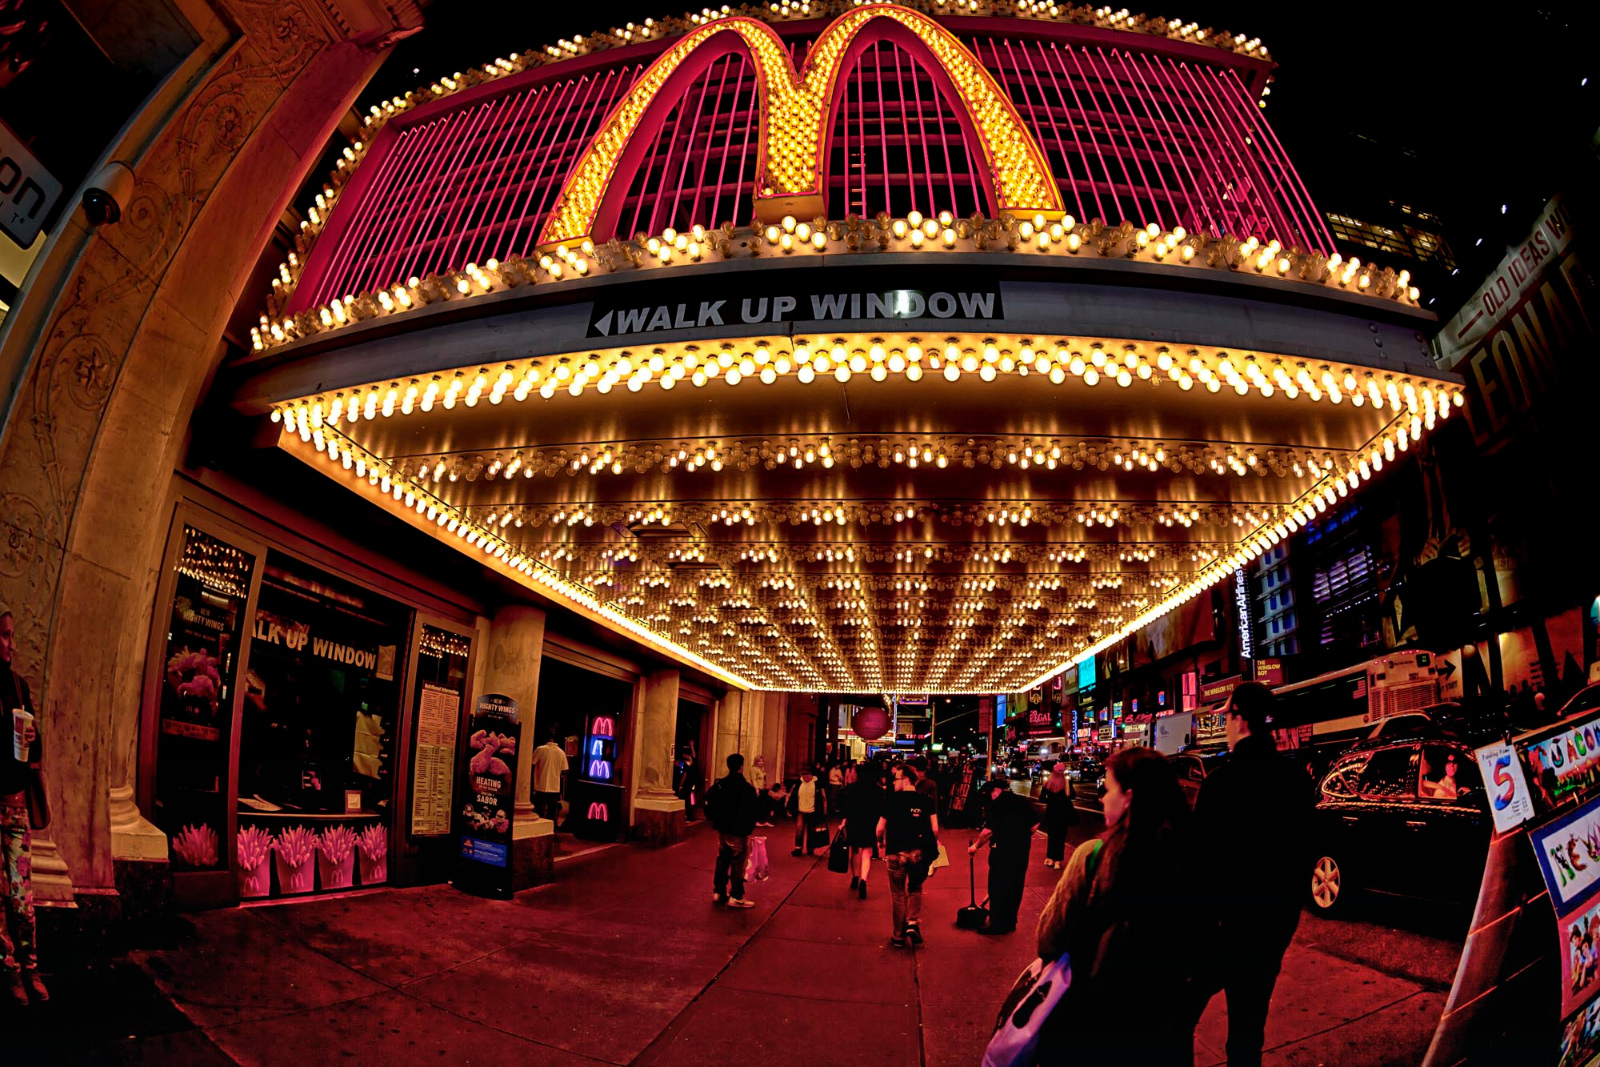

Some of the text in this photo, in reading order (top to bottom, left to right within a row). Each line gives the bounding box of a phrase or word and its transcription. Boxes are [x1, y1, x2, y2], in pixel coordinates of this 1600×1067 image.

[1482, 276, 1511, 316] OLD
[1507, 230, 1551, 288] IDEAS
[617, 292, 995, 334] WALK UP WINDOW
[205, 617, 225, 632] WINGS
[286, 629, 309, 651] UP
[313, 637, 377, 670] WINDOW
[479, 703, 516, 715] MIGHTY WINGS
[476, 776, 502, 789] HEATING
[476, 794, 498, 807] SABOR
